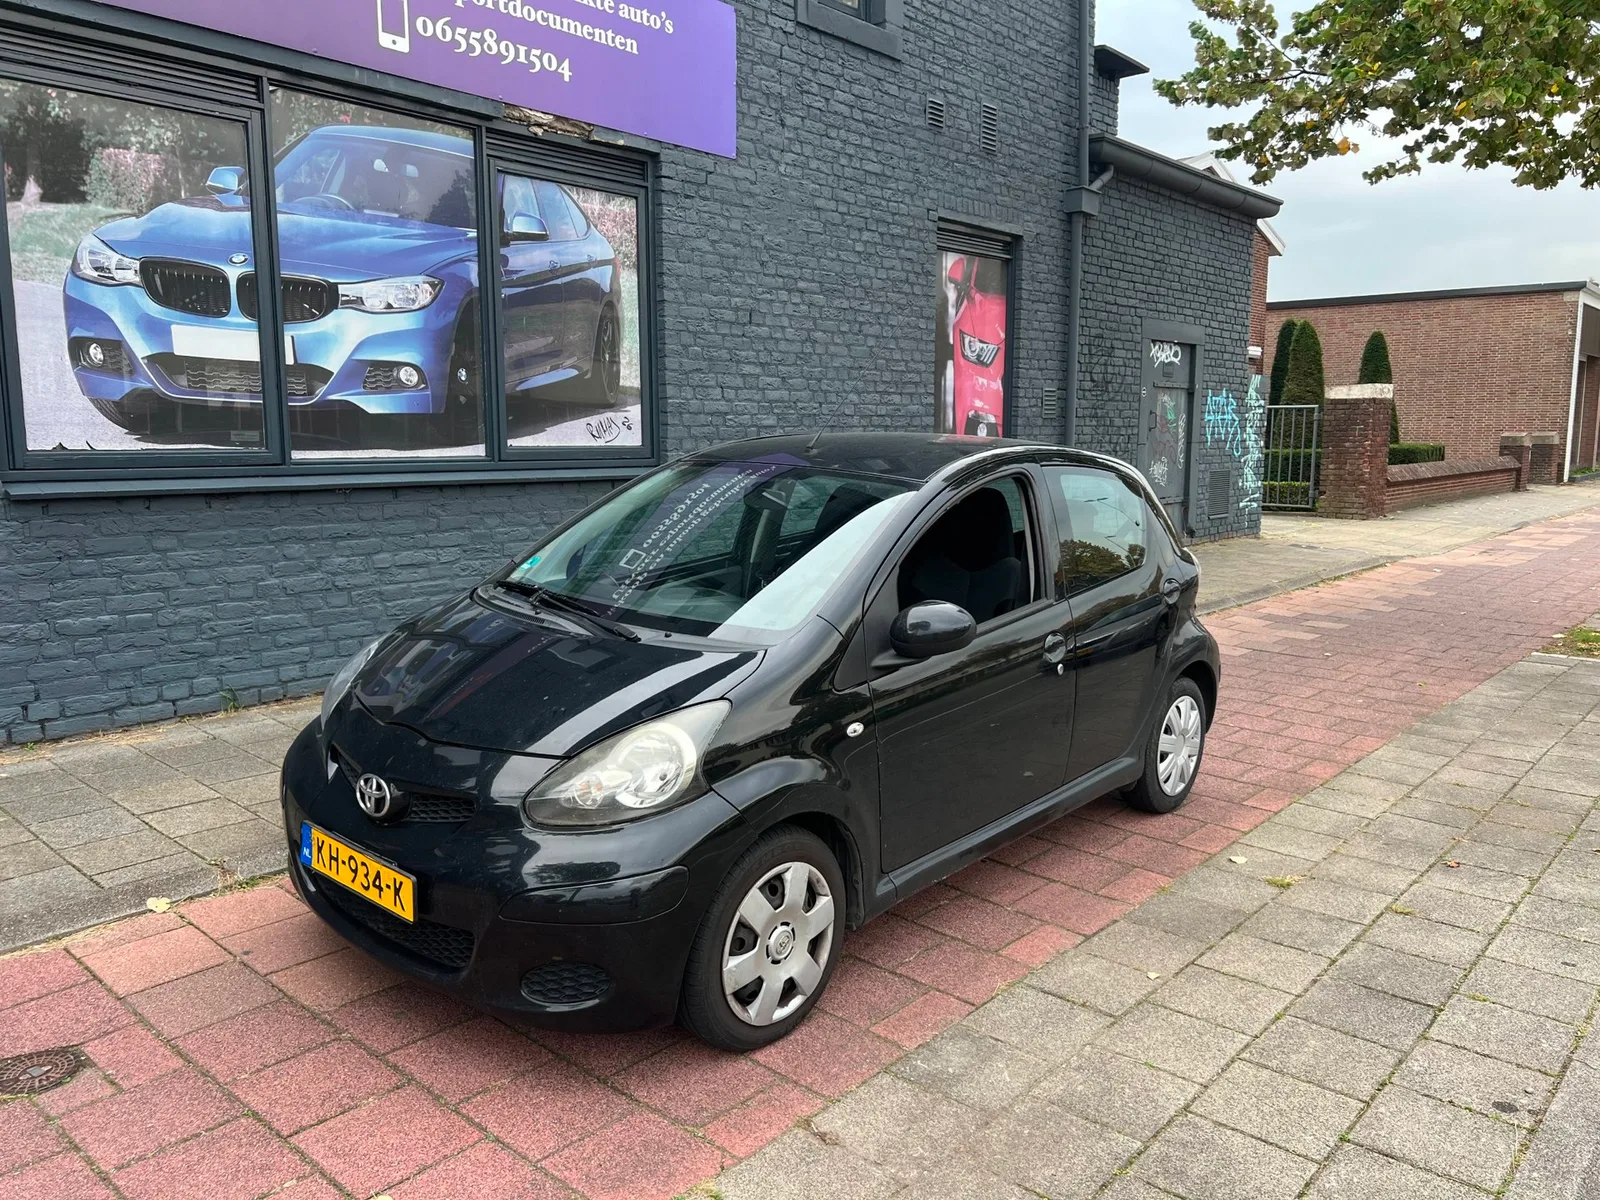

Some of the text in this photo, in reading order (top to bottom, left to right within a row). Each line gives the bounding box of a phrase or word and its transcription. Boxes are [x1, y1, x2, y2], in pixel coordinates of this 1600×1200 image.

[618, 3, 674, 34] auto's
[416, 16, 572, 82] 0655891504
[303, 846, 311, 858] NL
[316, 836, 406, 912] KH-934-K
